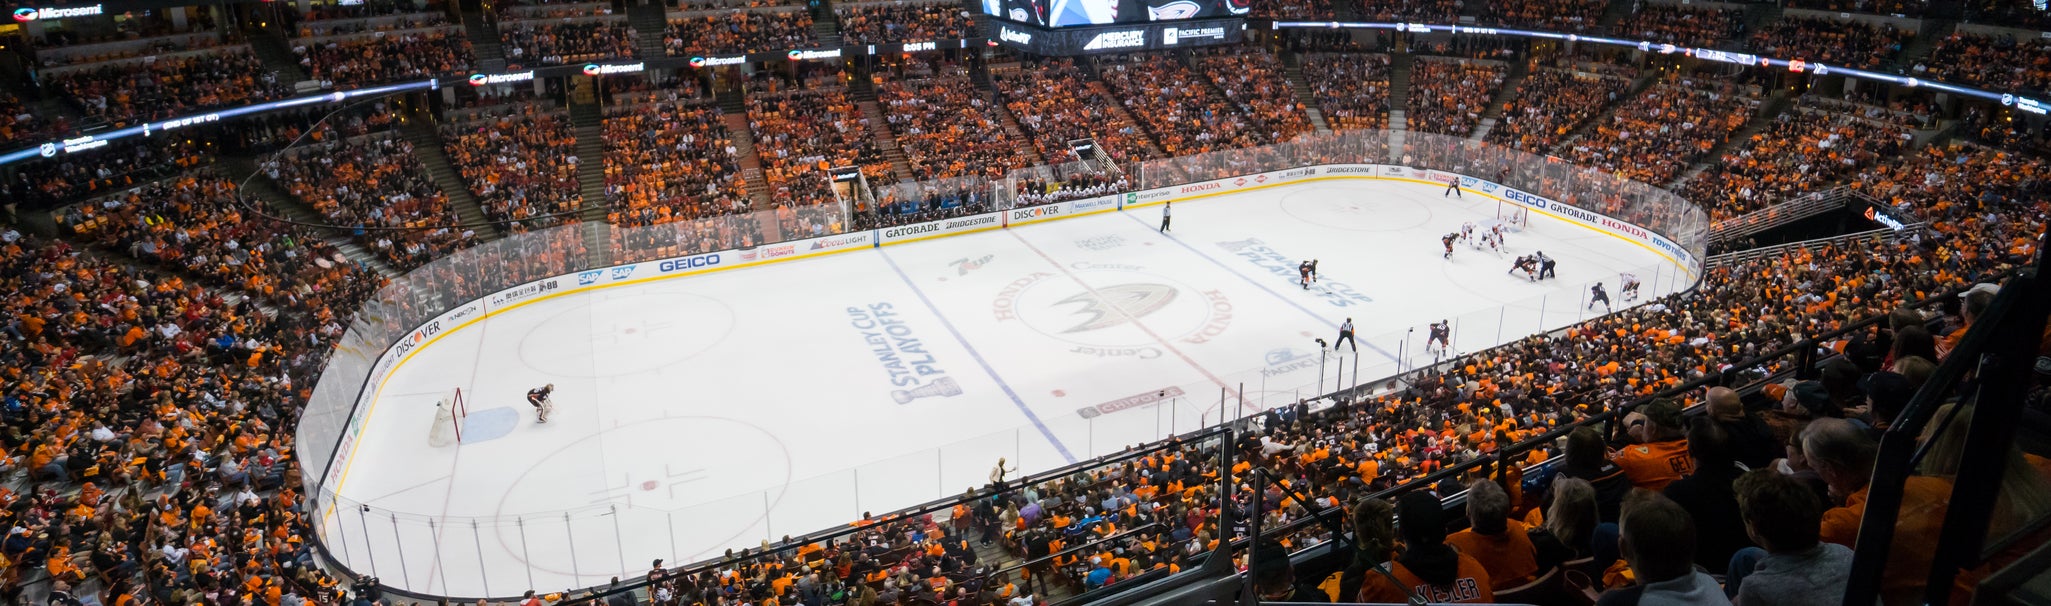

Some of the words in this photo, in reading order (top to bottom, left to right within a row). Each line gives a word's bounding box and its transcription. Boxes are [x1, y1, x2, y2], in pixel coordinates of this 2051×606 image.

[39, 4, 103, 19] Microsemi
[1103, 30, 1144, 40] MERCURY
[923, 42, 936, 50] PM
[1103, 38, 1144, 48] INSURANCE
[706, 55, 746, 66] Microsemi
[803, 49, 841, 59] Microsemi
[601, 62, 644, 74] Microsemi
[488, 71, 533, 84] Microsemi
[1326, 166, 1370, 174] BRIDGESTONE
[1181, 182, 1221, 193] HONDA
[1505, 189, 1546, 209] GEICO
[1014, 205, 1059, 220] DISCOVER
[1550, 203, 1598, 223] GATORADE
[946, 215, 996, 229] BRIDGESTONE
[1601, 217, 1648, 240] HONDA
[885, 223, 939, 238] GATORADE
[820, 239, 844, 248] Coors
[845, 235, 867, 245] LIGHT
[1652, 237, 1671, 251] TOYO
[659, 254, 720, 272] GEICO
[579, 273, 599, 283] SAP
[613, 268, 632, 279] SAP
[992, 271, 1053, 322] HONDA
[847, 306, 876, 330] CUP
[1181, 288, 1233, 345] HONDA
[396, 320, 441, 358] DISCOVER
[868, 301, 945, 376] PLAYOFFS
[861, 331, 920, 387] STANLEY
[1070, 346, 1162, 359] Center
[330, 434, 353, 484] HONDA
[1415, 577, 1481, 603] KESLER
[318, 594, 329, 603] 15
